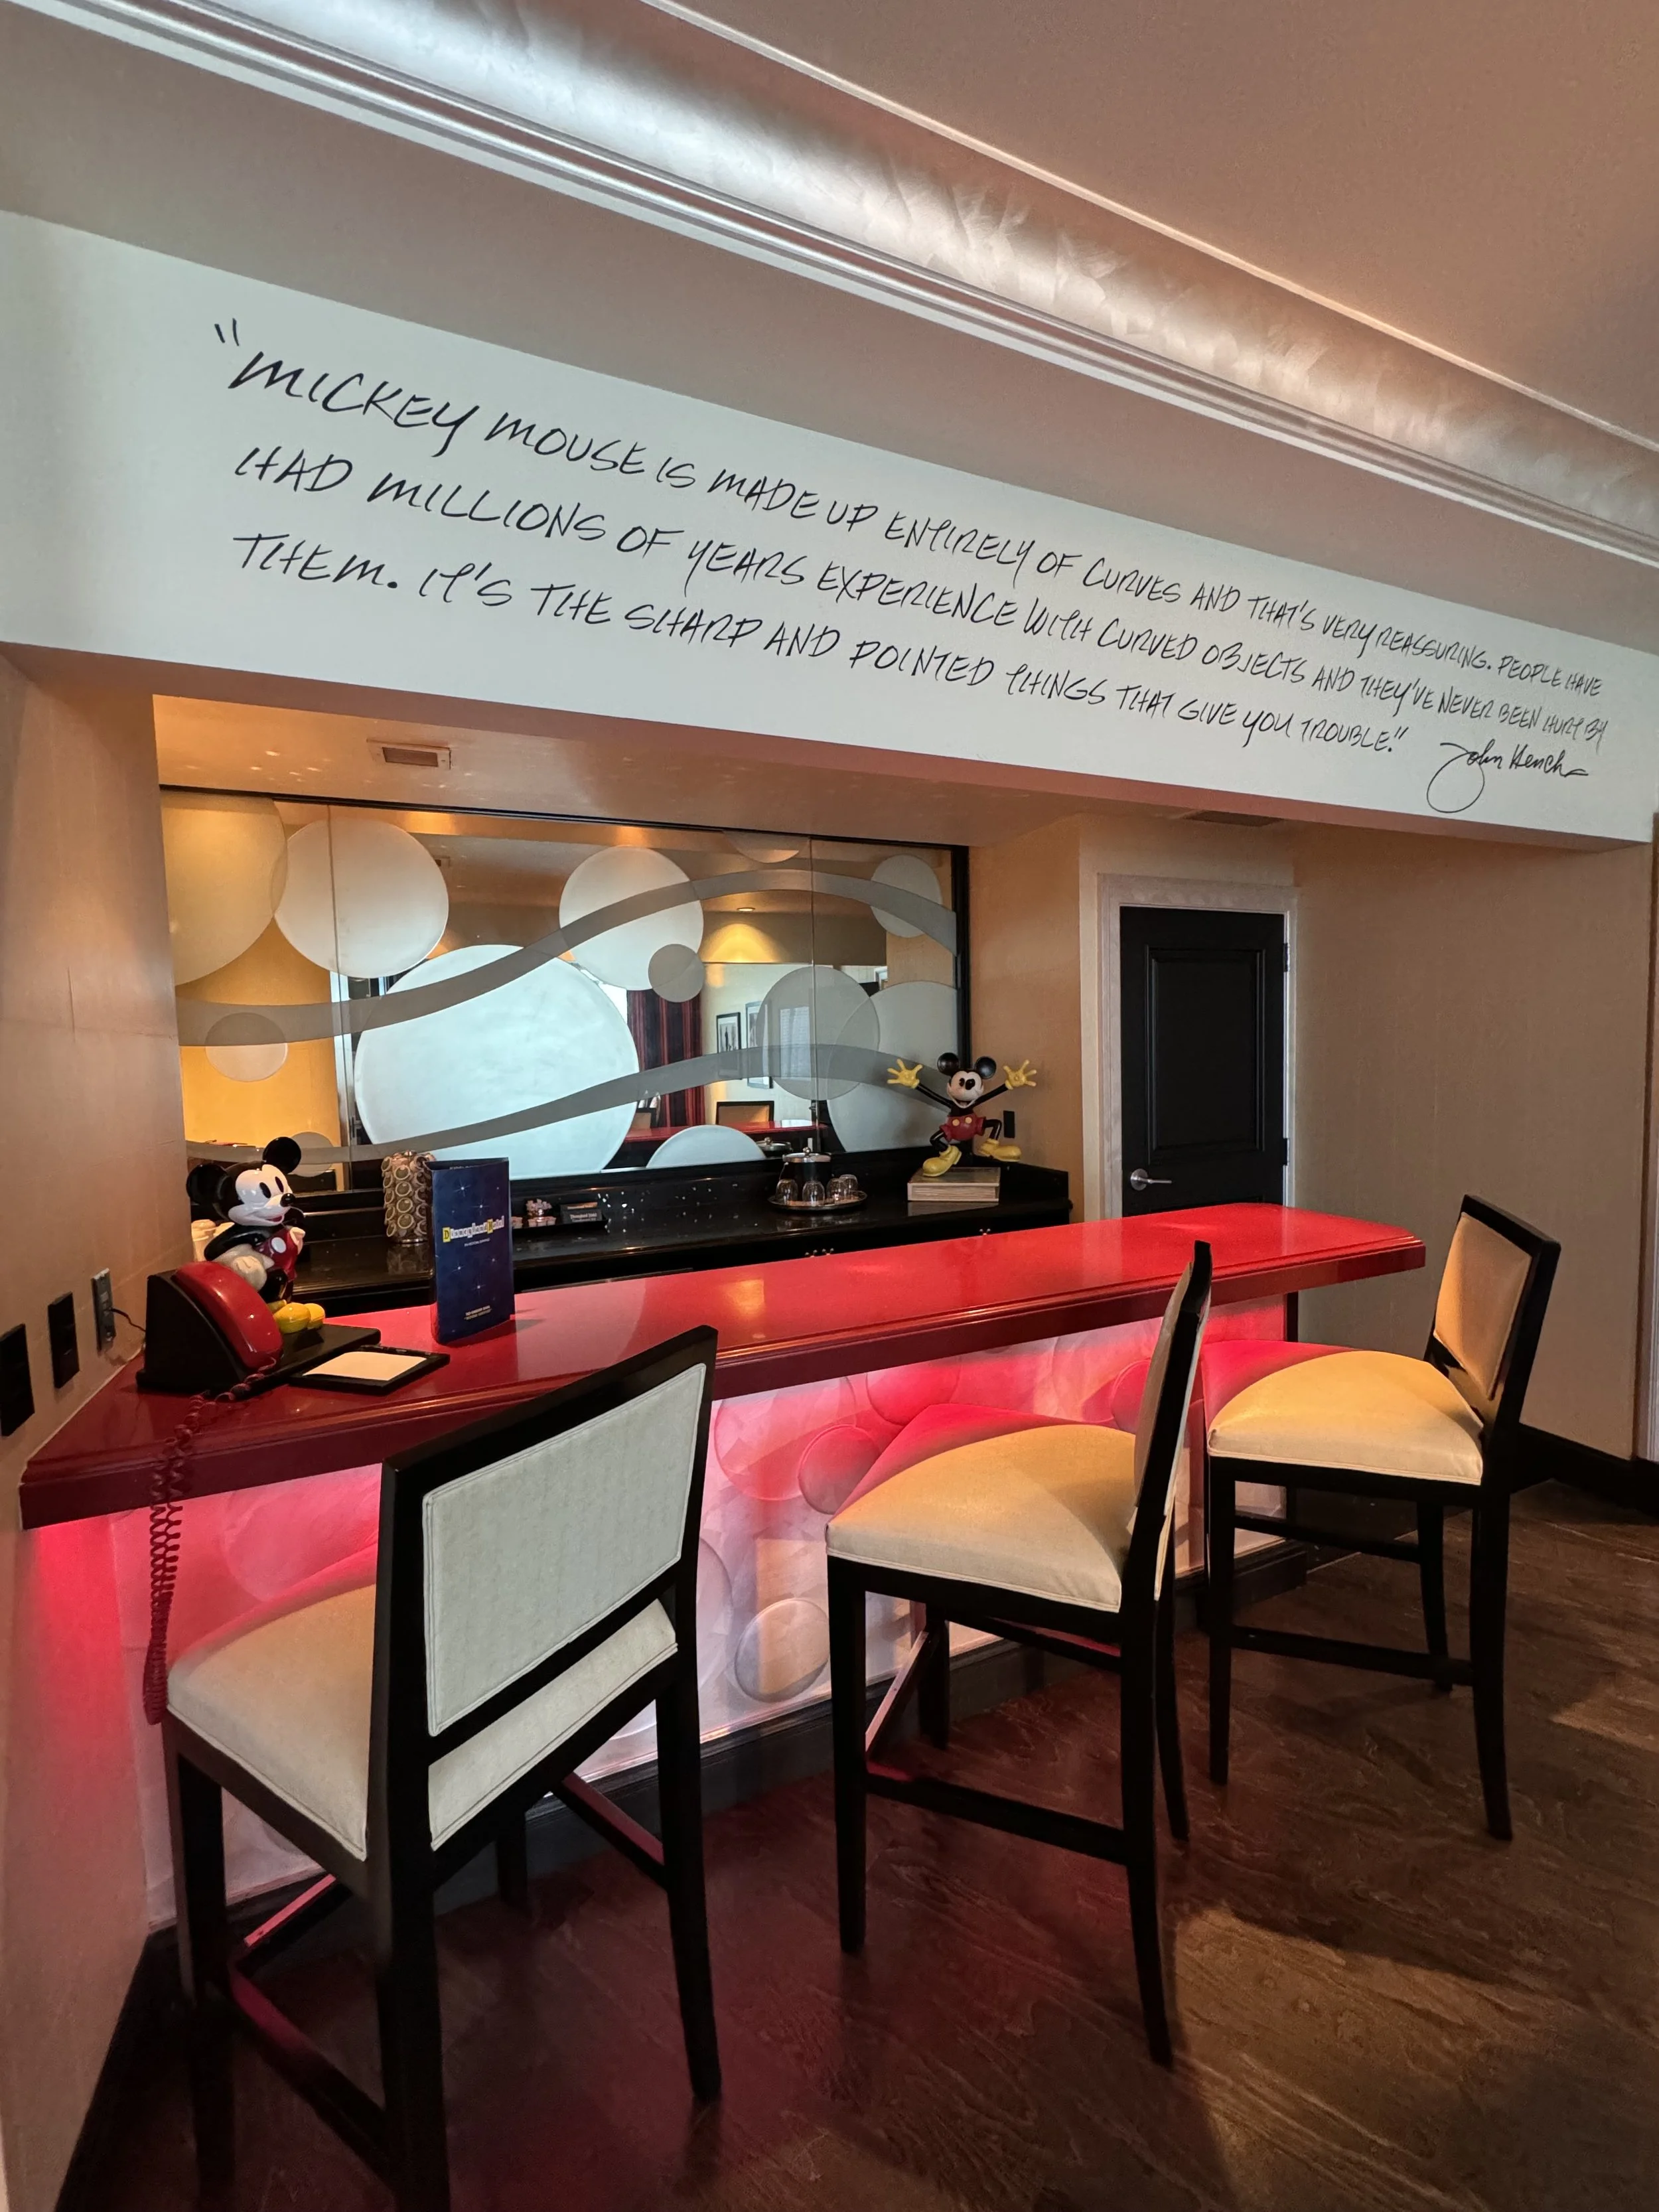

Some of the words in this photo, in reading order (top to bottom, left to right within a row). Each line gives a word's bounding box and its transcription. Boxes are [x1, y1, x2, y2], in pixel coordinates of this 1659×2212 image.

[233, 534, 397, 589] THEM.
[419, 562, 512, 607] IT'S
[530, 583, 613, 625] THE
[624, 604, 763, 648] SHARP
[763, 621, 840, 657] AND
[849, 640, 994, 686] POINTED
[1006, 664, 1108, 705] THINGS
[1116, 685, 1176, 719] THAT
[1178, 699, 1238, 725] GIVE
[1242, 710, 1294, 748] YOU
[234, 446, 353, 492] HAD
[366, 472, 606, 541] MILLIONS
[616, 526, 685, 559] OF
[684, 540, 808, 597] YEARS
[817, 561, 1017, 626] EXPERIENCE
[1023, 597, 1094, 642] WITH
[1097, 618, 1198, 660] CURVED
[1202, 642, 1307, 683] OBJECTS
[1311, 665, 1355, 692] AND
[1360, 675, 1434, 717] THEY'VE
[1437, 686, 1494, 719] NEVER
[1498, 703, 1543, 729] BEEN
[1542, 714, 1585, 740] HURT
[1584, 718, 1609, 755] BY
[484, 412, 646, 475] MOUSE
[656, 457, 695, 488] IS
[707, 469, 820, 519] MADE
[827, 500, 879, 532] UP
[885, 511, 1035, 589] ENTIRELY
[1037, 552, 1082, 578] OF
[1082, 557, 1181, 603] CURVES
[1190, 582, 1240, 612] AND
[1248, 596, 1317, 630] THAT'S
[1323, 615, 1378, 658] VERY
[1376, 627, 1491, 670] REASSURING.
[1498, 656, 1562, 687] PEOPLE
[1565, 673, 1602, 696] HAVE
[1427, 739, 1502, 814] John
[1509, 744, 1589, 778] Hench
